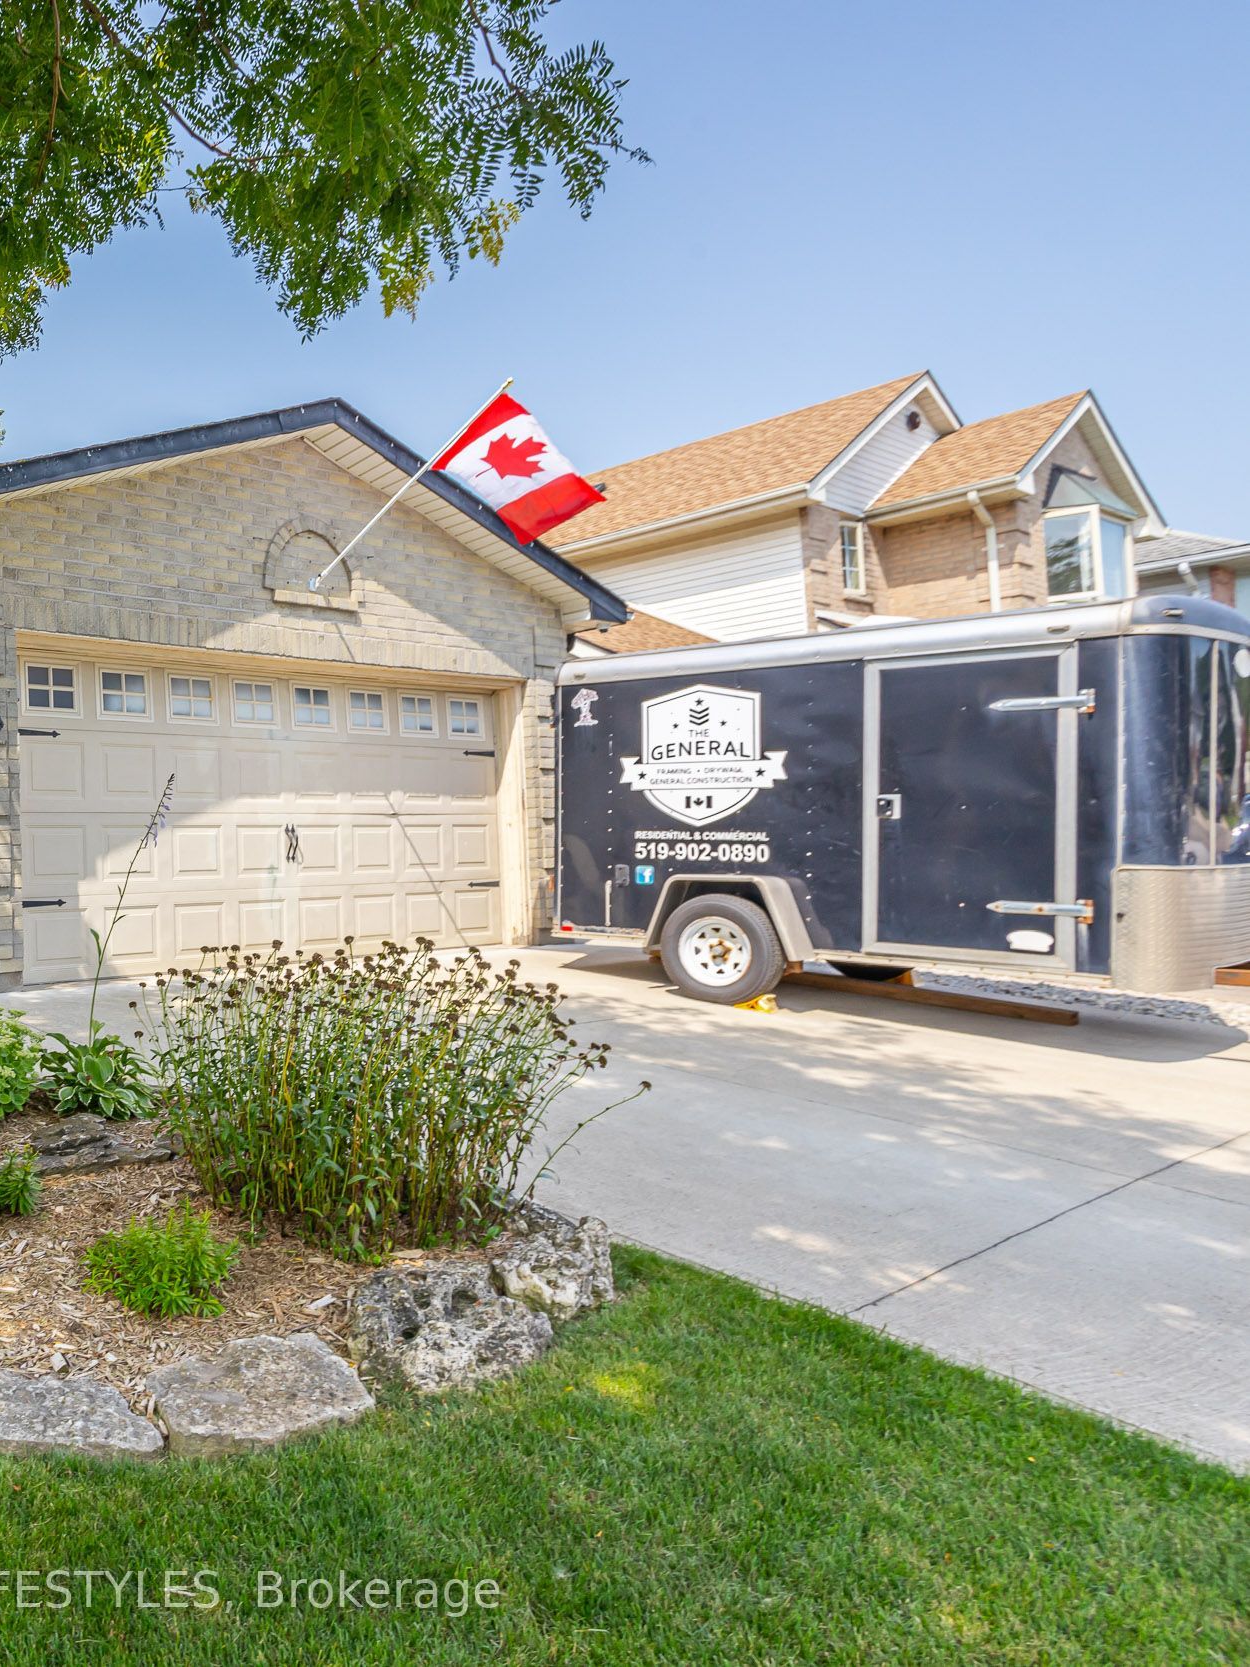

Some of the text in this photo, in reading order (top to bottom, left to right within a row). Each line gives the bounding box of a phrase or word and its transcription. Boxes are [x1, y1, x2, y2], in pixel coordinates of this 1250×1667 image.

[688, 728, 710, 738] THE
[651, 740, 751, 761] GENERAL
[649, 776, 752, 785] GENERAL CONSTRUCTION
[634, 830, 770, 841] RESIDENTIAL & COMMERCIAL
[634, 841, 770, 863] 519-902-0890
